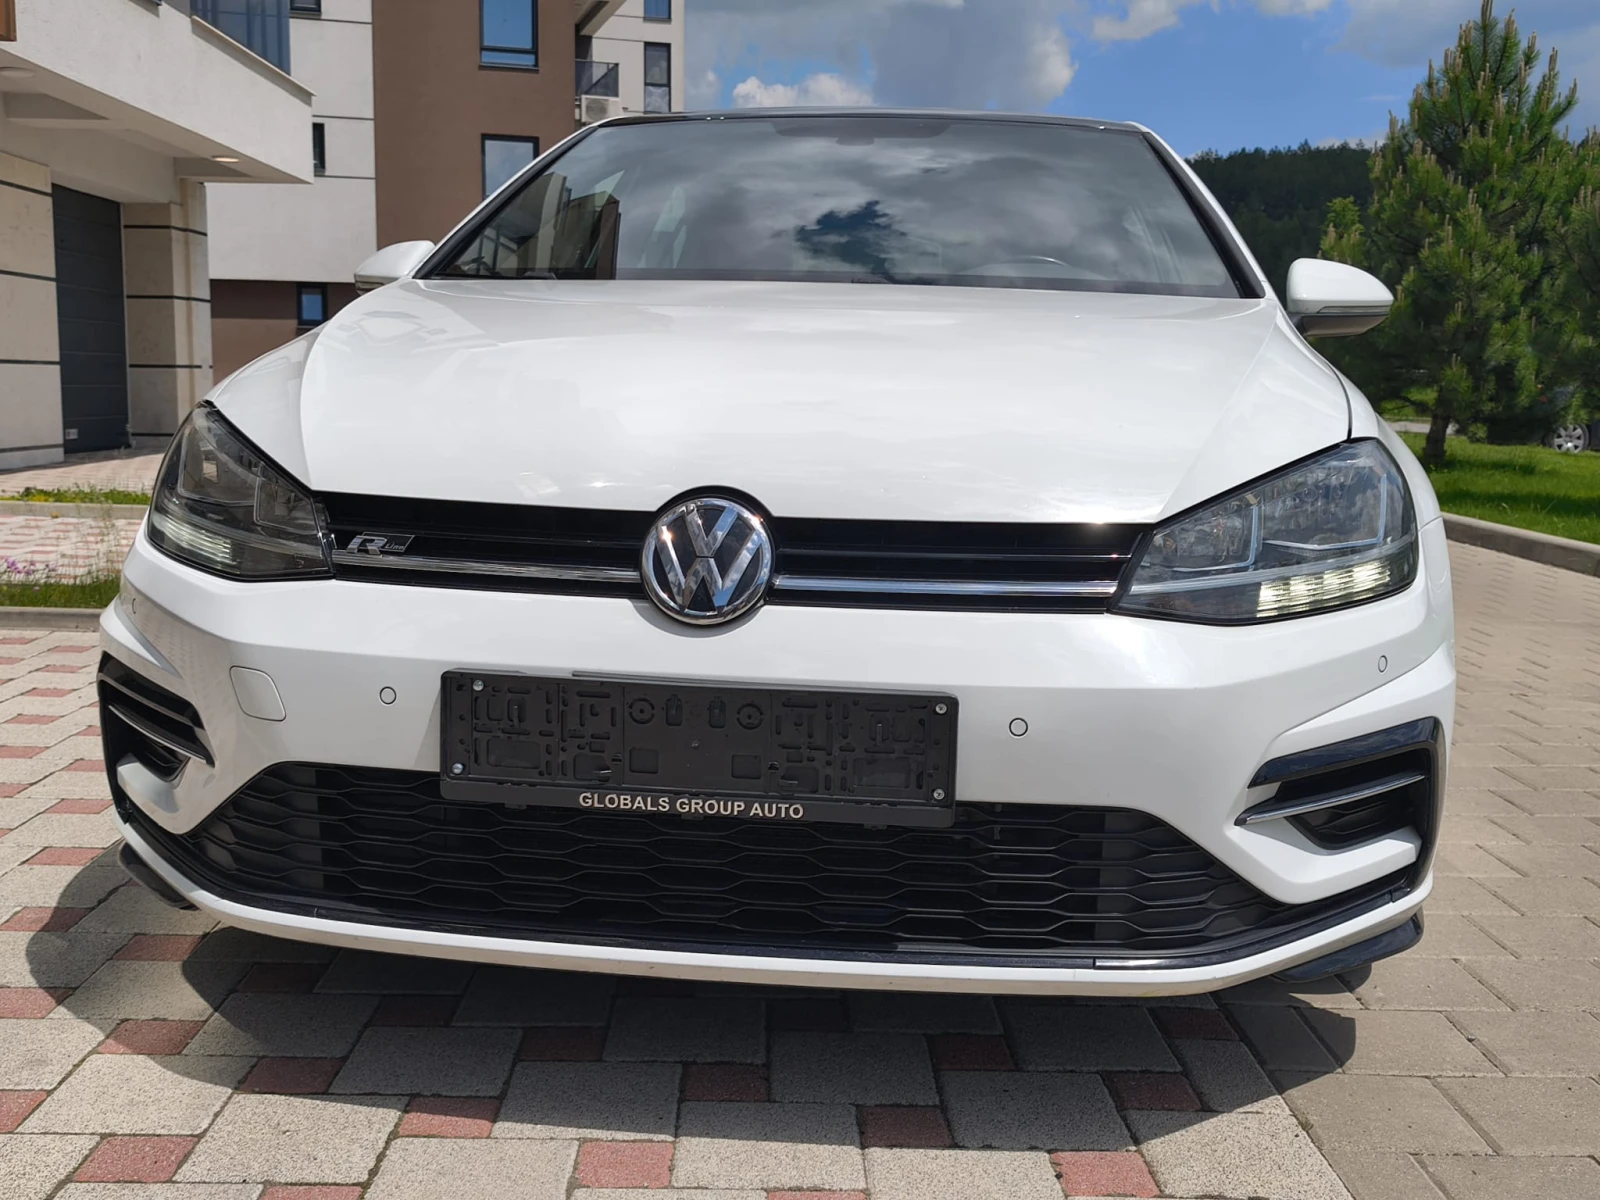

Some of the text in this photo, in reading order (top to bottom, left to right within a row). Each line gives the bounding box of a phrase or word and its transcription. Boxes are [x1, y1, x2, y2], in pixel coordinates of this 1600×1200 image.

[579, 792, 804, 819] GLOBALS GROUP AUTO
